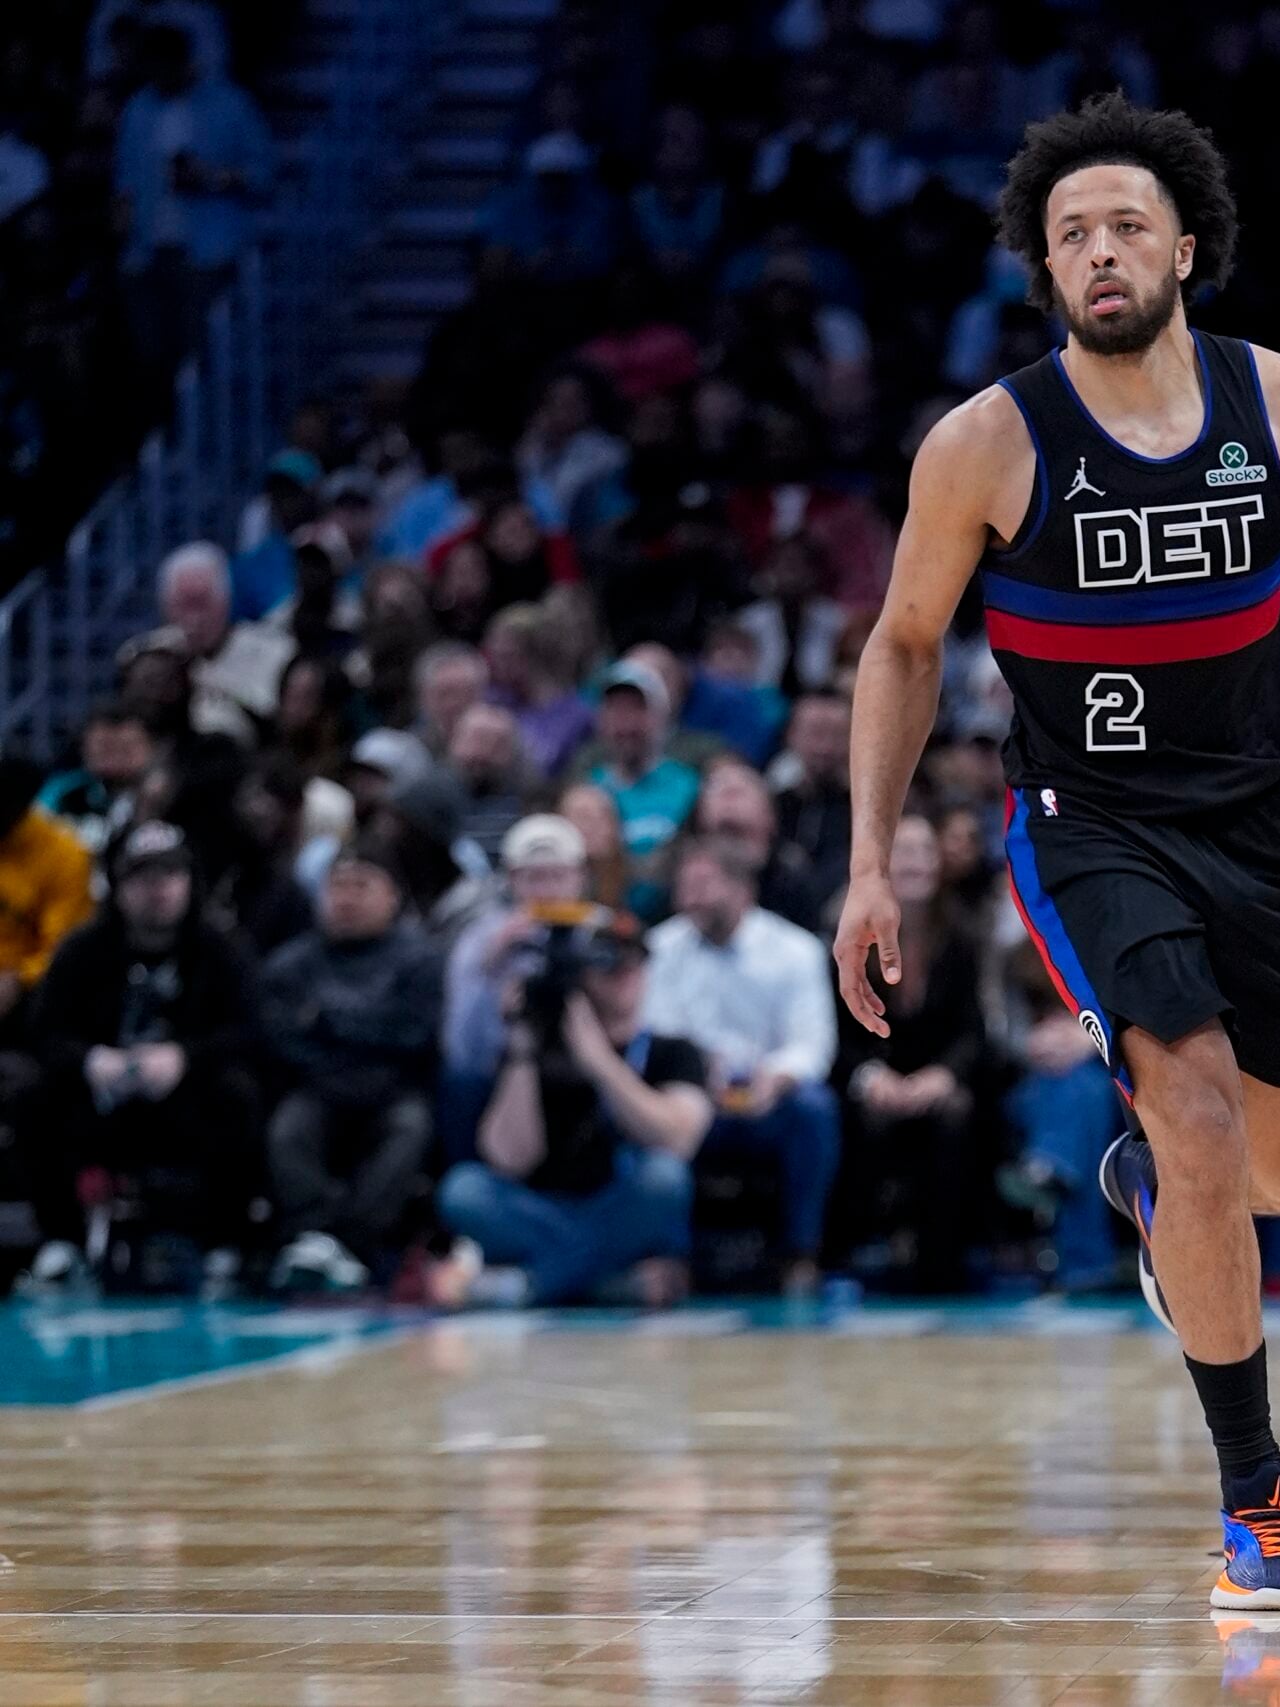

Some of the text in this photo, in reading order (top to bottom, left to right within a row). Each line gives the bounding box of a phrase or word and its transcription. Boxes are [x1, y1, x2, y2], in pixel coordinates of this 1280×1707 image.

[1208, 468, 1265, 484] StockX
[1074, 495, 1265, 588] DET
[1085, 672, 1146, 752] 2
